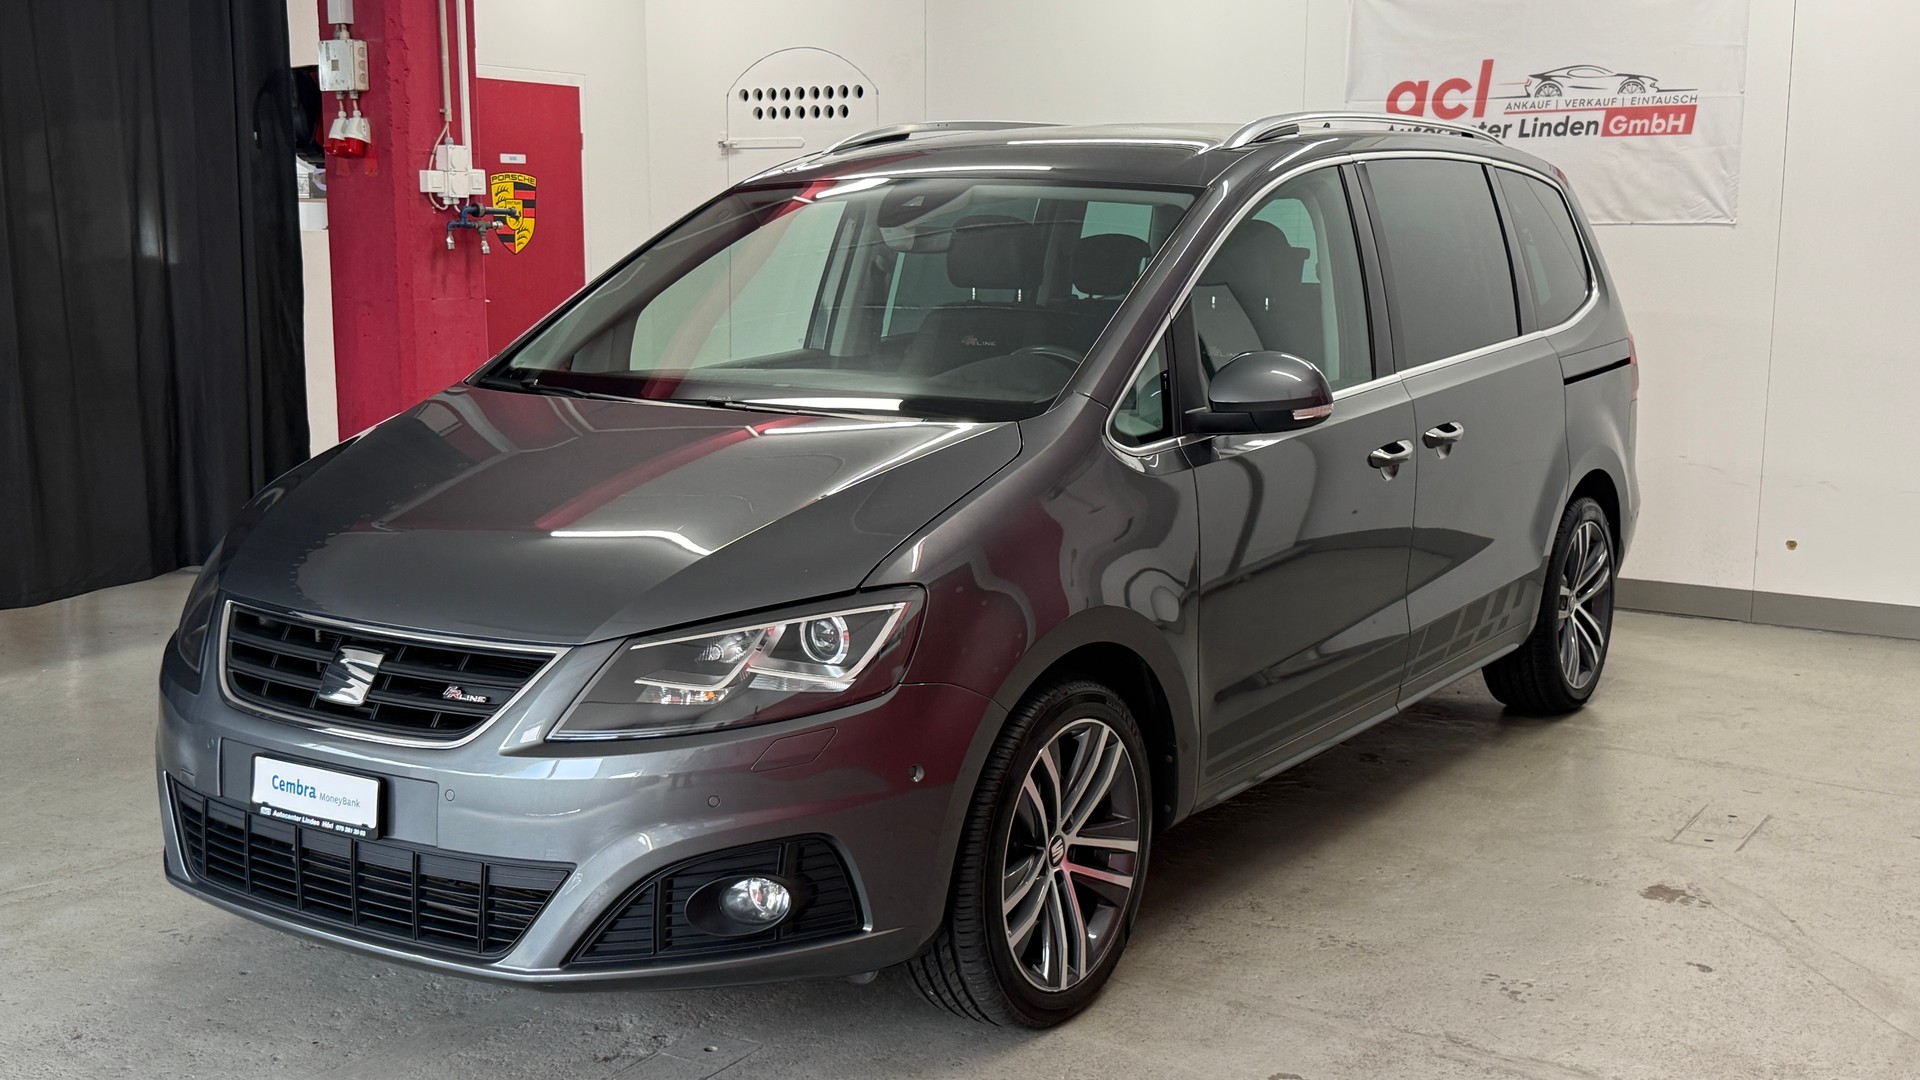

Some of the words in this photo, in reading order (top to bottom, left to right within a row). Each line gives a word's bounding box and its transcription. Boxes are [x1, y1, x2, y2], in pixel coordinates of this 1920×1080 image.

[1386, 59, 1494, 120] acl
[1505, 100, 1551, 110] ANKAUF
[1564, 98, 1617, 108] VERKAUF
[1630, 95, 1698, 106] EINTAUSCH
[1518, 116, 1599, 138] Linden
[1609, 113, 1686, 135] GmbH
[492, 174, 535, 185] PORSCHE
[271, 775, 316, 799] Cembra
[319, 792, 360, 808] MoneyBank
[272, 810, 301, 821] Autocenter
[301, 816, 320, 826] Linden
